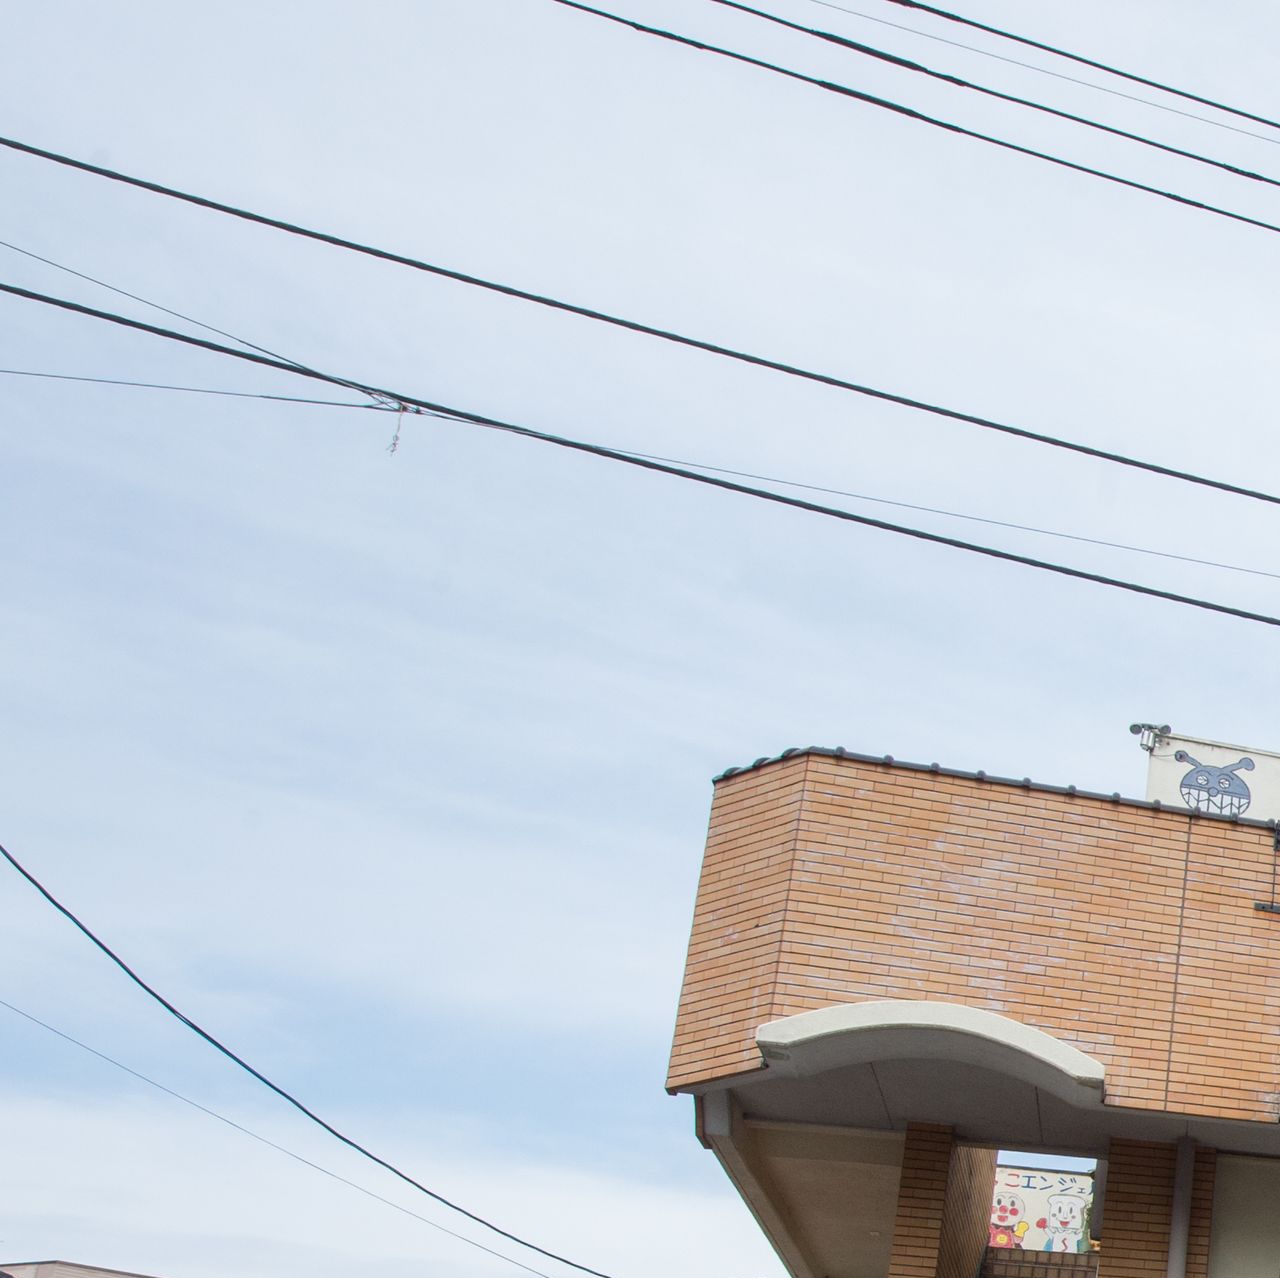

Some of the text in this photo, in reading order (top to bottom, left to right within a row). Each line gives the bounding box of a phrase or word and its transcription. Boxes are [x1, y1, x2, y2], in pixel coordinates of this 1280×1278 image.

[995, 1172, 1095, 1195] こエンジェ
